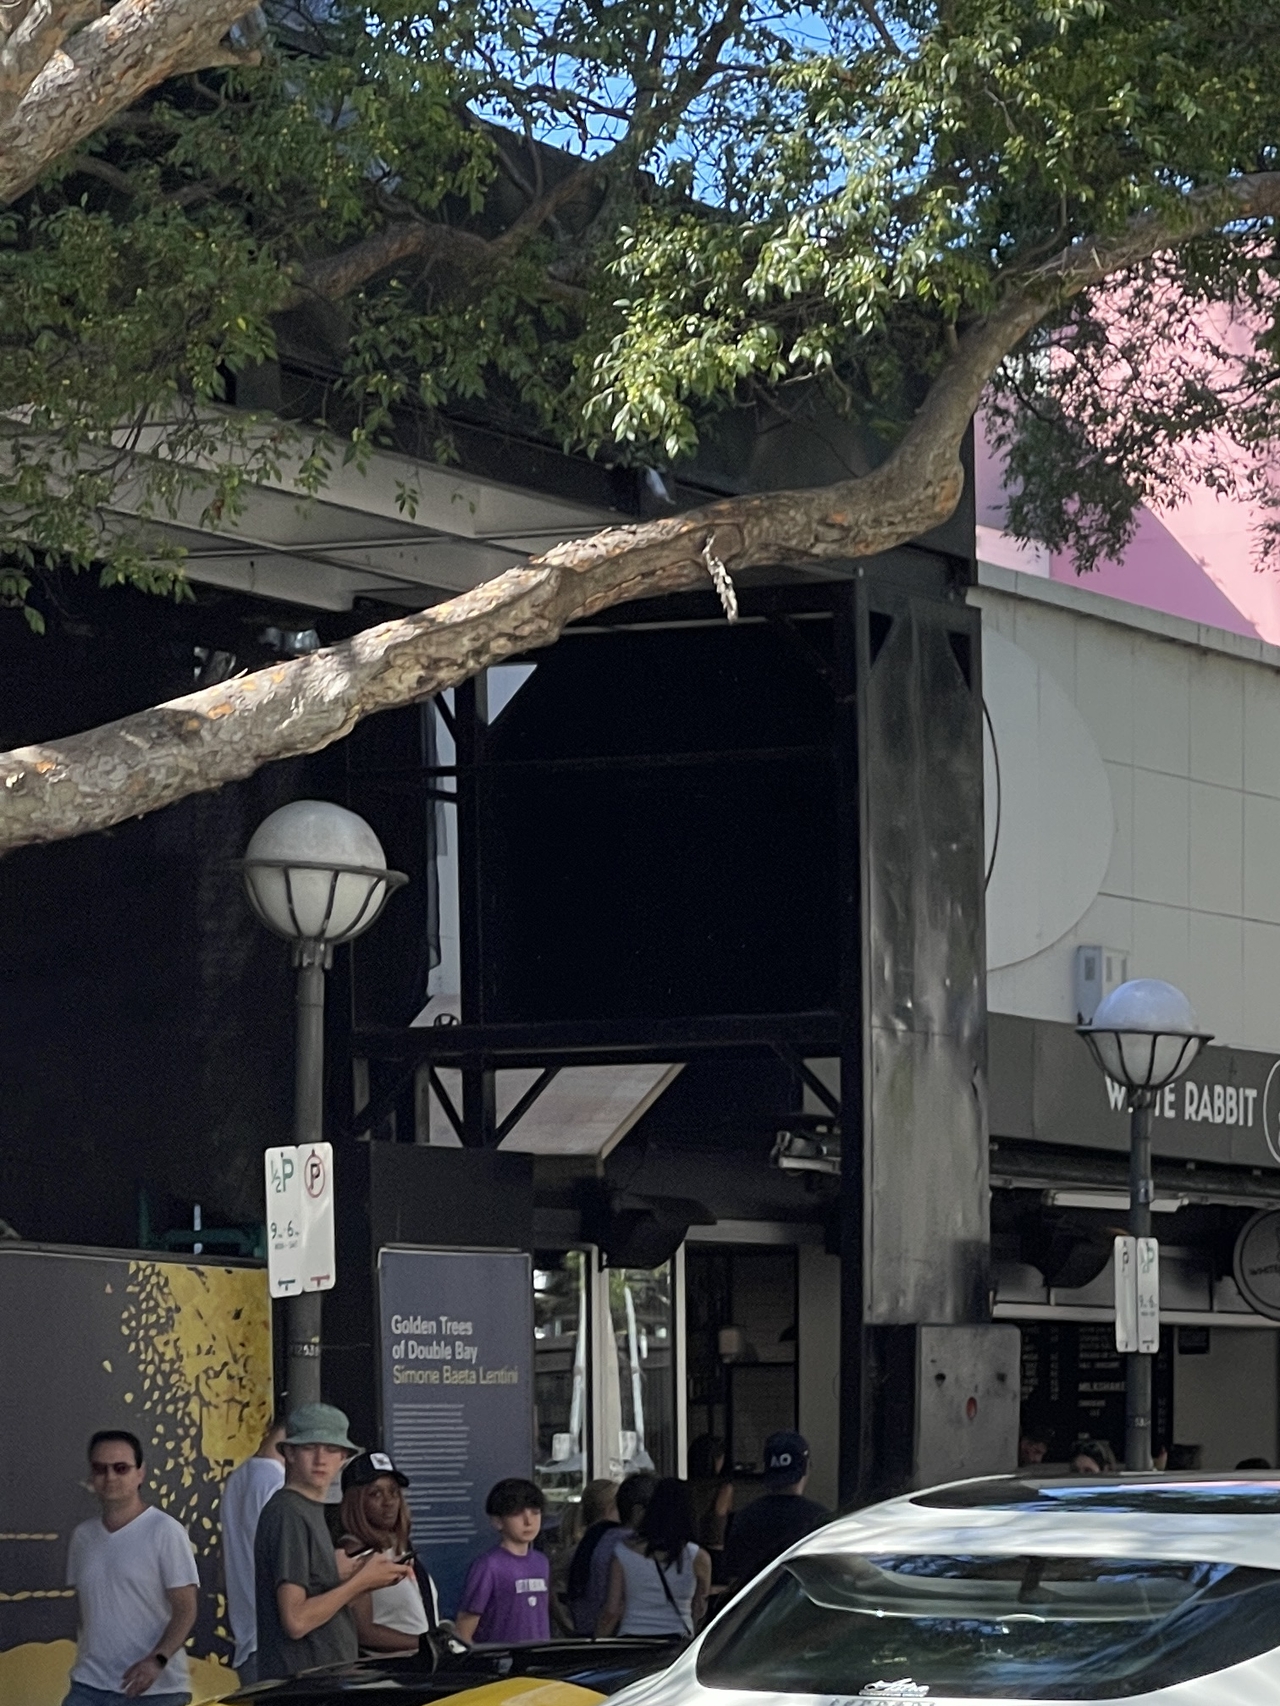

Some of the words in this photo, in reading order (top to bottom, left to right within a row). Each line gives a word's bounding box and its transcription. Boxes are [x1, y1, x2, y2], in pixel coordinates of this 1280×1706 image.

[1184, 1081, 1258, 1127] RABBIT
[391, 1315, 437, 1335] Golden
[439, 1316, 473, 1335] Trees
[392, 1340, 406, 1360] of
[408, 1341, 452, 1360] Double
[455, 1341, 478, 1364] Bay
[393, 1365, 440, 1384] Simone
[443, 1366, 477, 1384] Baeta
[480, 1367, 518, 1384] Lentini
